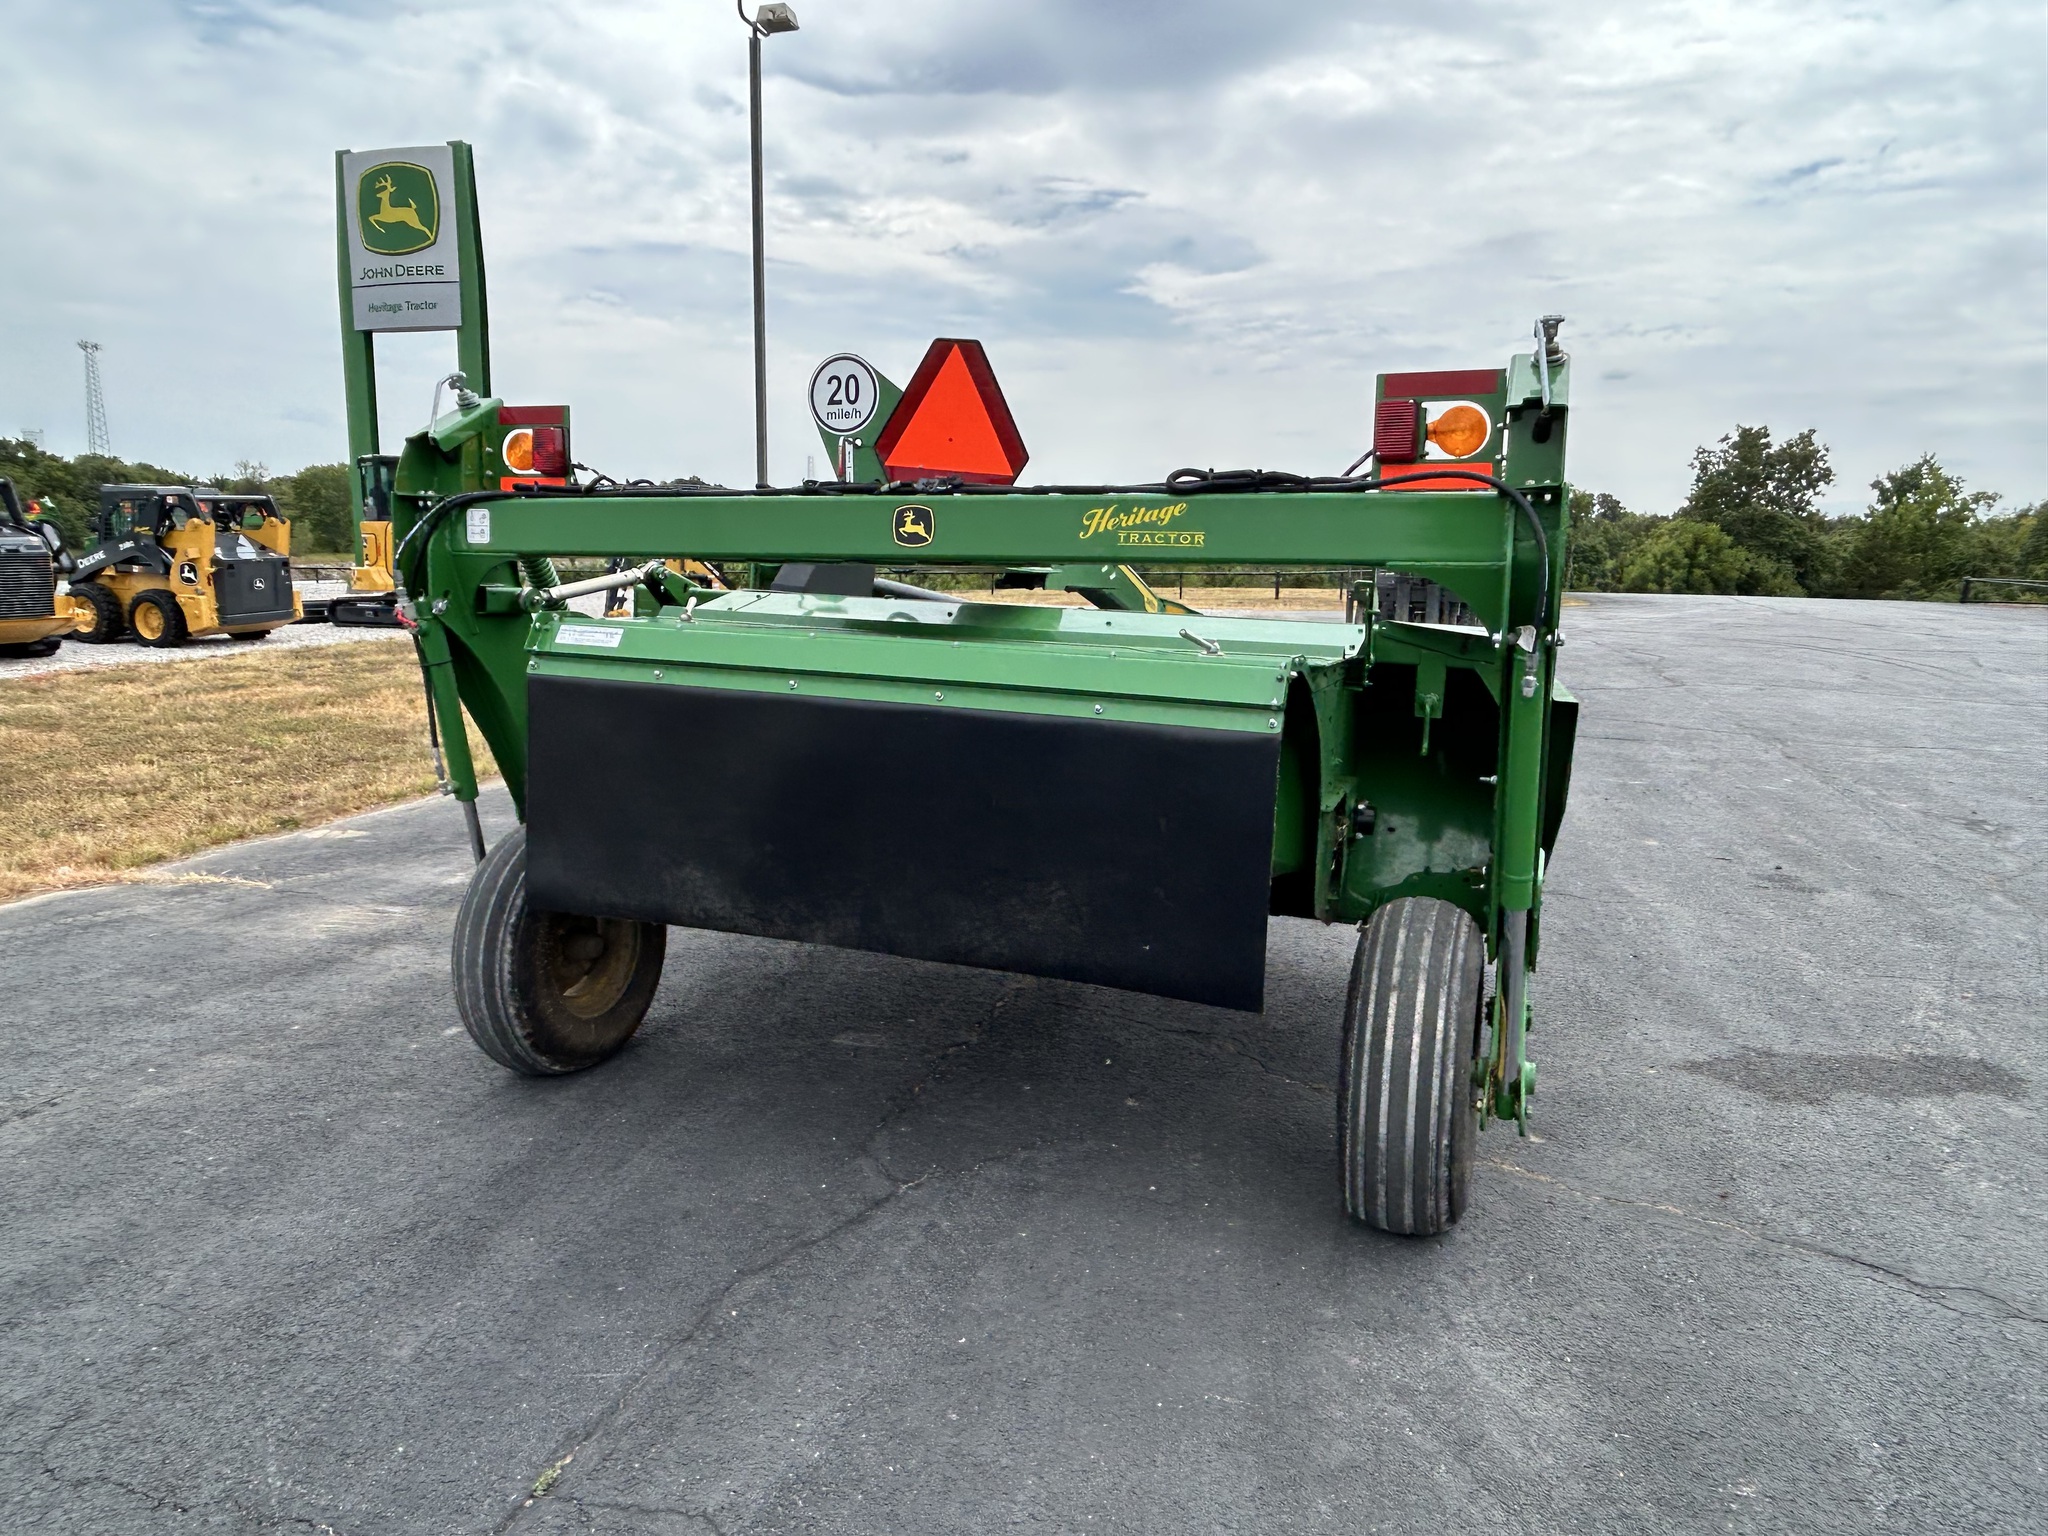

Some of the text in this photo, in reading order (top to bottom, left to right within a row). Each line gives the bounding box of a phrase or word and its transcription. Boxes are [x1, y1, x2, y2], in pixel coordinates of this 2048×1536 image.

[360, 264, 444, 280] JOHN DEERE
[368, 300, 438, 314] Heritage Tractor
[827, 374, 860, 406] 20
[826, 408, 862, 421] mile/h
[1079, 501, 1188, 539] Heritage
[1118, 533, 1205, 546] TRACTOR
[77, 550, 106, 568] DEERE
